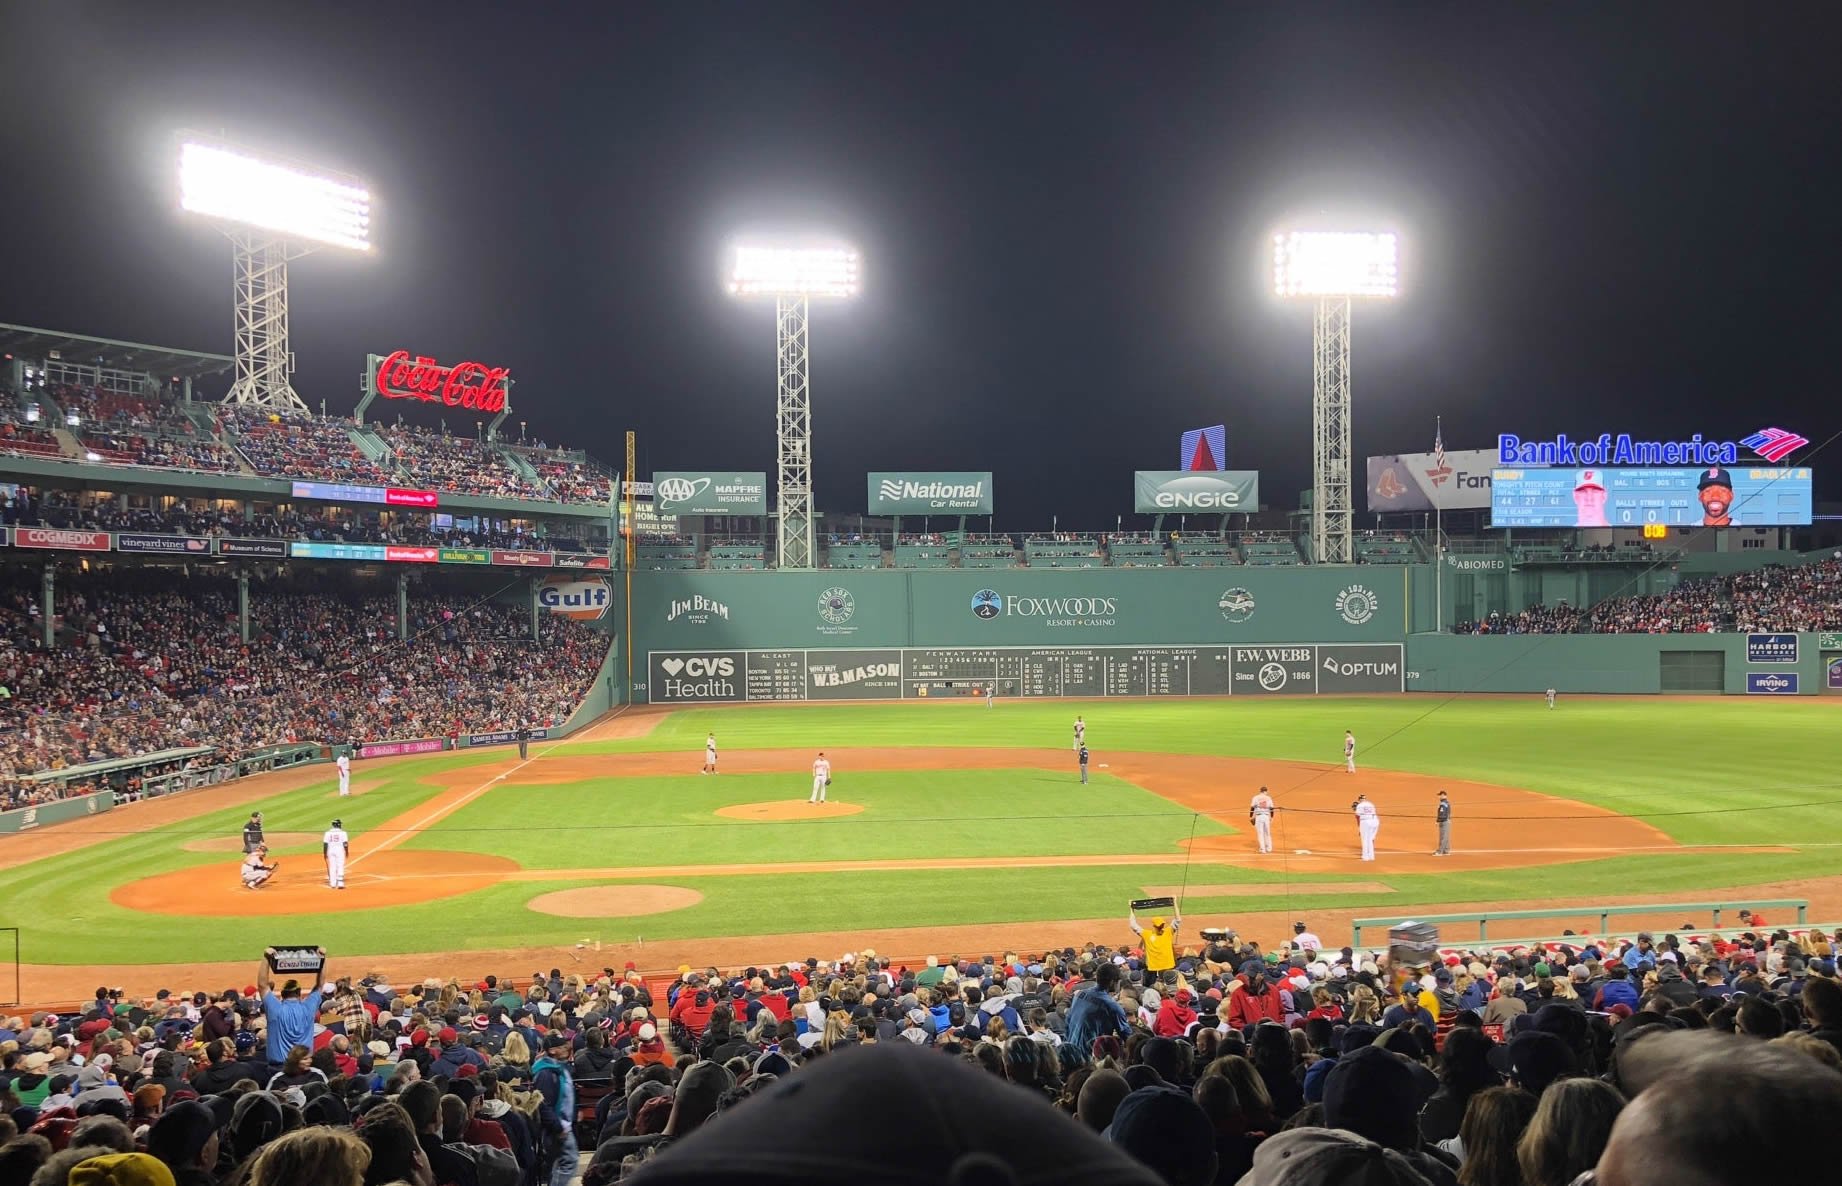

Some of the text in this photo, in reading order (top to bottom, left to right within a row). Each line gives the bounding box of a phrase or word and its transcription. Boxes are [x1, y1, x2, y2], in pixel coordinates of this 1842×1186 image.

[377, 350, 511, 413] Coca-Cola
[1498, 433, 1737, 464] Bank of America
[662, 480, 693, 497] AAA
[716, 485, 761, 493] MAPFRE
[903, 481, 983, 499] National
[930, 500, 978, 508] Car Rental
[1501, 497, 1512, 505] 44
[1525, 497, 1536, 505] 27
[1622, 510, 1631, 522] 0
[1648, 510, 1656, 522] 0
[28, 530, 97, 546] COGMEDIX
[122, 537, 185, 550] vineyard vines
[559, 559, 584, 567] Safelite
[1457, 560, 1505, 570] ABIOMED
[539, 587, 606, 606] Gulf
[834, 588, 849, 599] SOX
[667, 594, 729, 621] JIM BEAM
[1006, 595, 1117, 616] FOXWOODS
[821, 602, 854, 622] SCHOLARS
[1047, 618, 1116, 627] RESORT CASINO
[1237, 649, 1311, 662] F.W. WEBB
[685, 657, 735, 677] CVS
[1341, 663, 1397, 676] OPTUM
[1235, 672, 1254, 681] Since
[1292, 672, 1311, 680] 1866
[1406, 671, 1420, 679] 379
[664, 679, 736, 697] Health
[1756, 679, 1789, 687] IRVING
[472, 735, 491, 743] SAMUEL
[492, 733, 508, 741] ADAMS
[329, 834, 340, 843] 19
